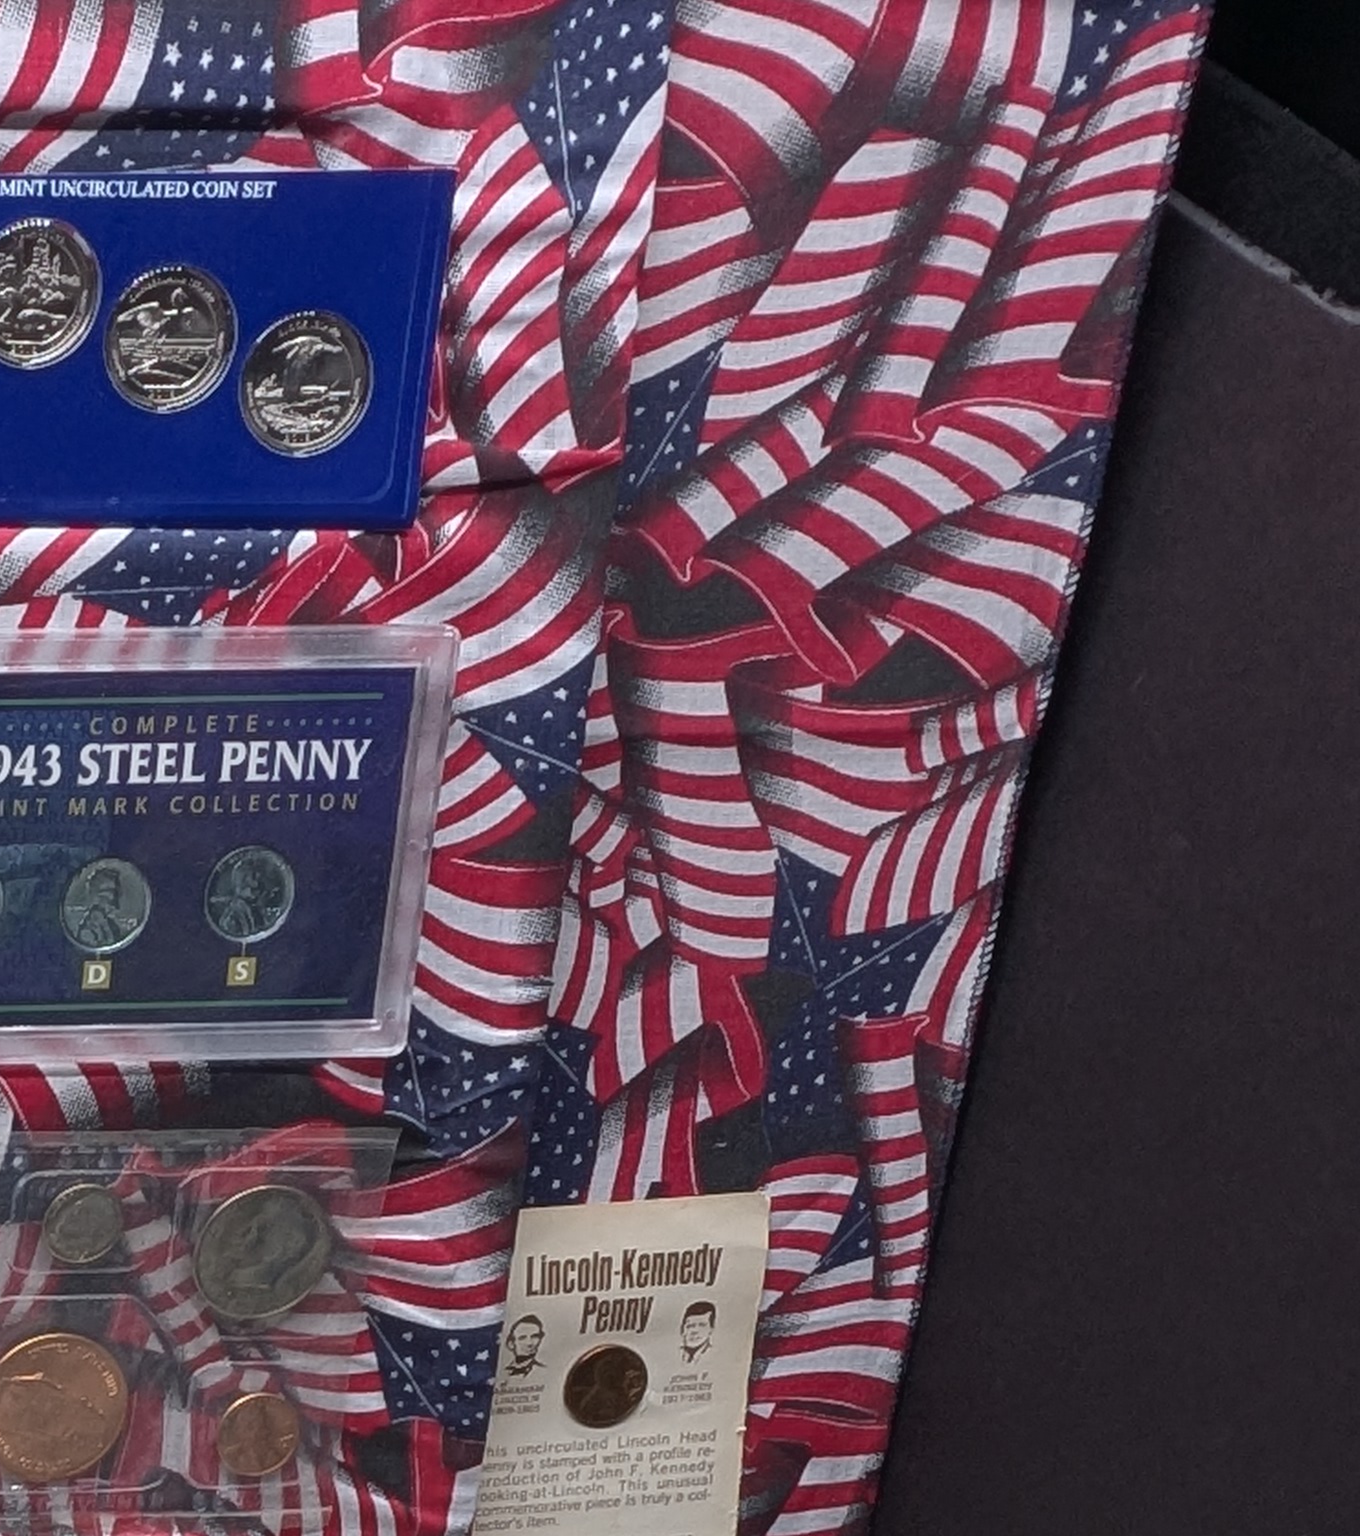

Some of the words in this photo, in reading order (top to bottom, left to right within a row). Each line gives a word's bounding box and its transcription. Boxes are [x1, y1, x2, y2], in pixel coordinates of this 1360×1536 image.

[0, 179, 48, 197] MINT
[50, 179, 188, 198] UNCIRCULATED
[191, 180, 239, 198] COIN
[241, 181, 277, 198] SET
[89, 713, 260, 736] COMPLETE
[77, 741, 205, 786] STEEL
[217, 738, 372, 784] PENNY
[67, 795, 149, 817] MARK
[169, 792, 360, 816] COLLECTION
[88, 965, 106, 985] D
[234, 960, 248, 982] S
[525, 1243, 723, 1297] Lincoln-Kennedy
[579, 1295, 654, 1335] Penny
[516, 1437, 609, 1456] uncirculated
[617, 1433, 671, 1449] Lincoln
[679, 1429, 717, 1443] Head
[522, 1458, 535, 1471] is
[539, 1453, 597, 1470] stamped
[602, 1450, 631, 1464] with
[649, 1446, 692, 1464] profile
[565, 1469, 580, 1482] of
[587, 1466, 624, 1482] John
[649, 1458, 714, 1475] Kennedy
[618, 1478, 649, 1493] This
[656, 1473, 714, 1490] unusual
[475, 1499, 581, 1517] commemorative
[584, 1497, 622, 1513] piece
[641, 1491, 672, 1506] truly
